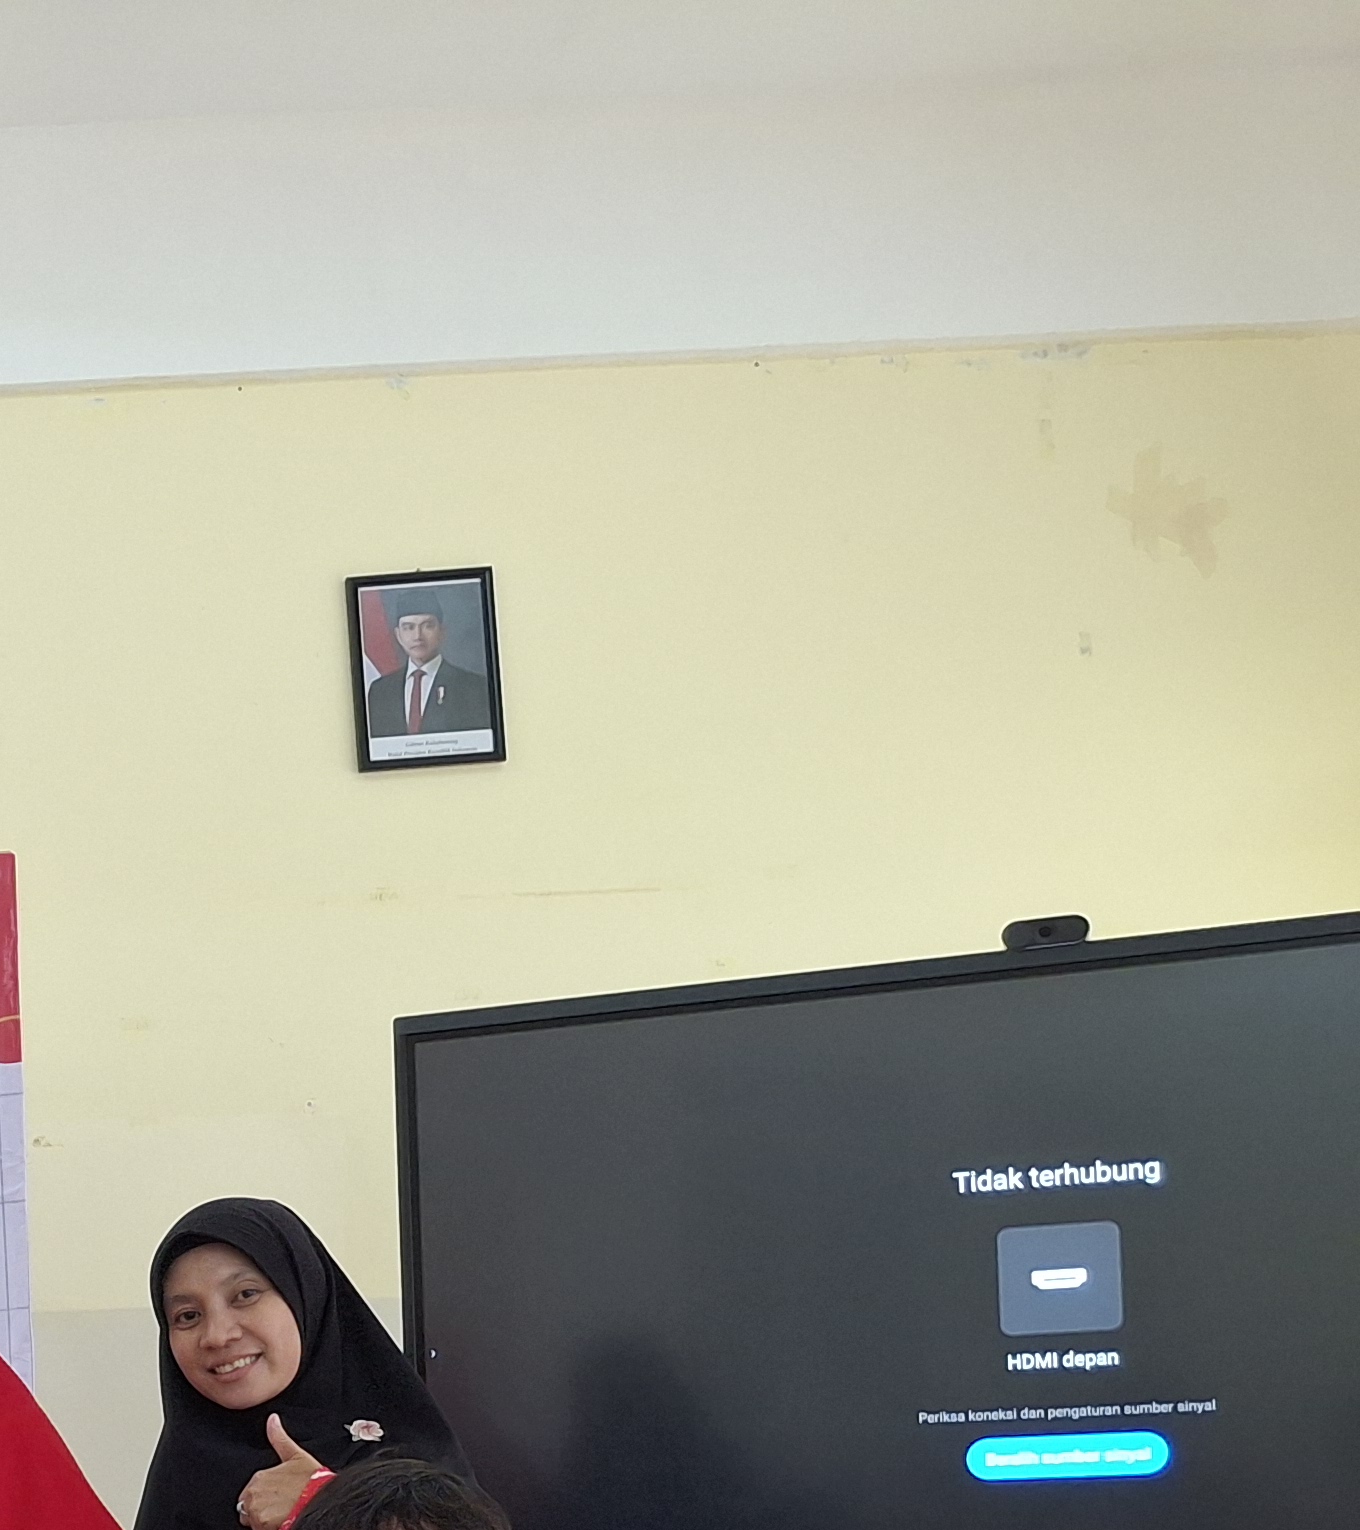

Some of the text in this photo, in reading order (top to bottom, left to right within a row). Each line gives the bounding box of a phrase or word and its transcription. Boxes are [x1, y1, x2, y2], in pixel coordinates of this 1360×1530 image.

[951, 1159, 1162, 1194] Tidak terhubung
[1007, 1350, 1120, 1371] HDMI depan
[918, 1399, 1217, 1424] Periksa koneksi dan pengaturan sumber sinyal
